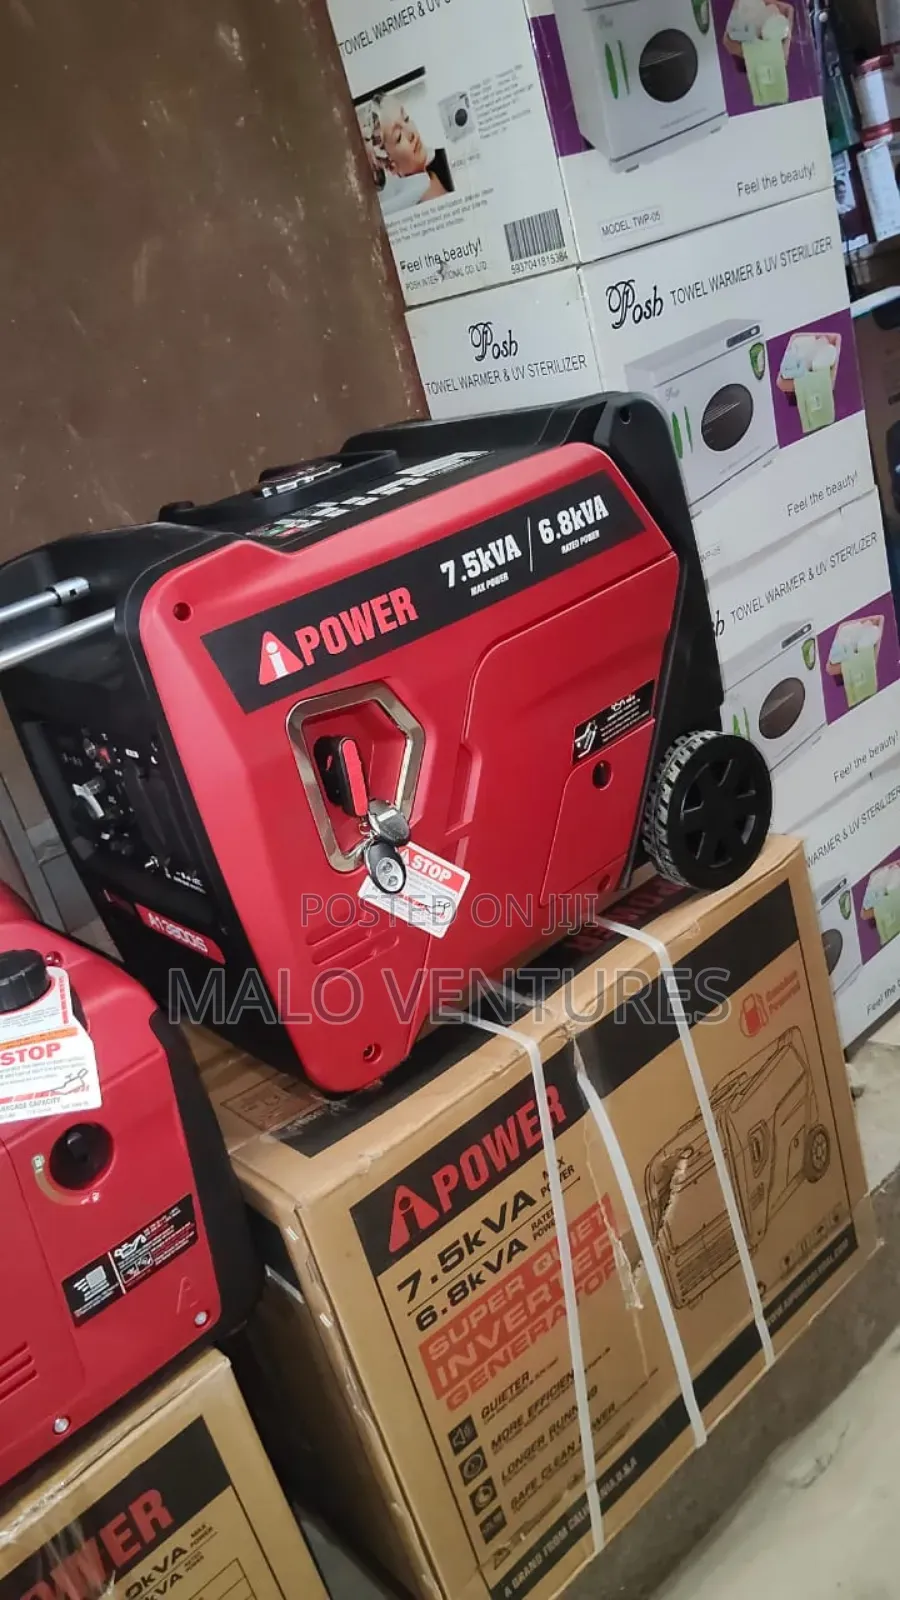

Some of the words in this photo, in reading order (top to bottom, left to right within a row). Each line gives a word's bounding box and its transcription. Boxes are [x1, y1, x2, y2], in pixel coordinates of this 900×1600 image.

[337, 30, 373, 56] TOWEL
[371, 6, 417, 40] WARMER
[417, 1, 425, 17] &
[737, 178, 760, 197] Feel
[762, 174, 778, 190] the
[780, 163, 816, 183] beauty!
[399, 257, 423, 273] Feel
[424, 251, 441, 268] the
[441, 236, 482, 262] beauty!
[605, 279, 664, 330] Posh
[670, 281, 708, 306] TOWEL
[708, 264, 754, 292] WARMER
[755, 261, 764, 276] &
[763, 256, 779, 273] UV
[779, 235, 833, 268] STERILIZER
[468, 321, 519, 362] Posh
[425, 379, 458, 396] TOWEL
[459, 369, 501, 389] WARMER
[503, 367, 511, 382] &
[512, 364, 527, 381] UV
[527, 353, 588, 379] STERILIZER
[786, 498, 808, 517] Feel
[809, 488, 825, 507] the
[825, 470, 859, 496] beauty!
[537, 494, 610, 545] 6.8kVA
[561, 539, 579, 555] RATED
[579, 529, 601, 547] POWER
[439, 534, 522, 589] 7.5kVA
[470, 582, 487, 597] MAX
[486, 571, 510, 589] POWER
[729, 596, 765, 624] TOWEL
[765, 571, 807, 605] WARMER
[808, 567, 815, 581] &
[815, 562, 828, 577] UV
[829, 531, 878, 569] STERILIZER
[833, 763, 852, 782] Feel
[853, 754, 867, 770] the
[868, 729, 899, 758] beauty!
[861, 785, 900, 825] STERILIZER
[411, 854, 452, 882] STOP
[1, 1042, 61, 1067] STOP
[397, 1190, 537, 1304] 7.5kVA
[416, 1238, 529, 1332] 6.8kVA
[428, 1275, 526, 1362] SUPER
[481, 1371, 530, 1420] QUIETER
[490, 1418, 525, 1451] MORE
[527, 1368, 575, 1418] EFFICIEN
[501, 1435, 546, 1481] LONGER
[510, 1477, 536, 1510] SAFE
[541, 1440, 576, 1482] CLEAN
